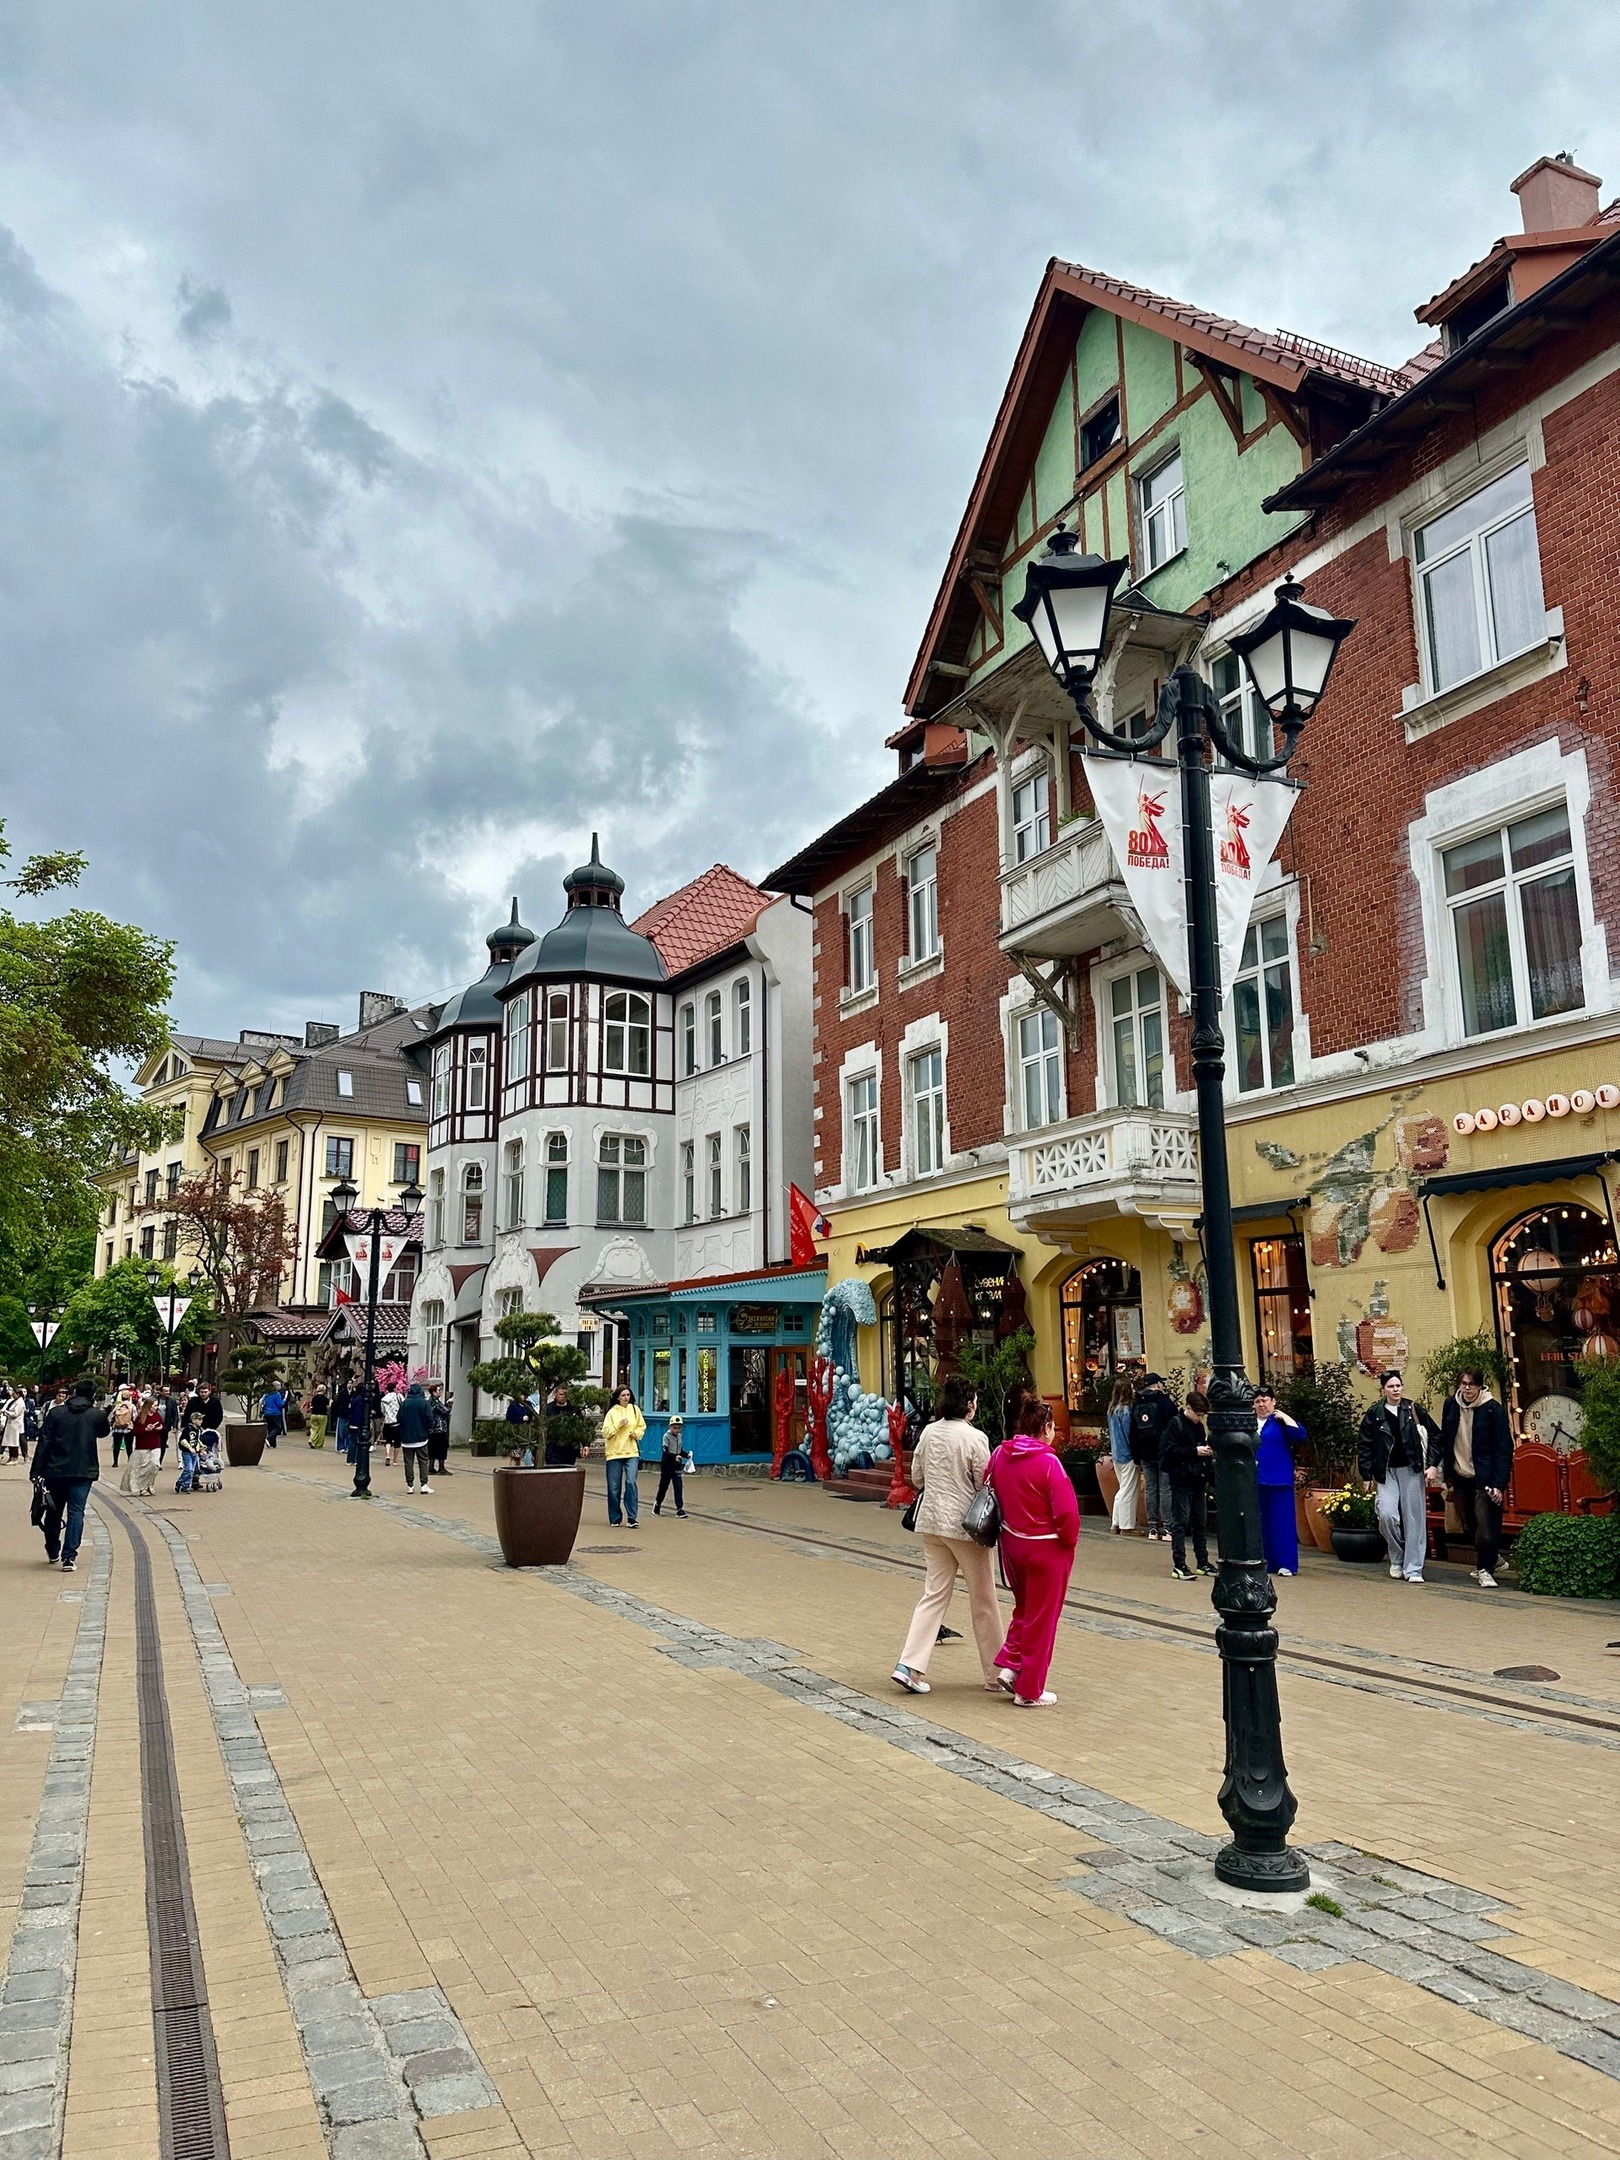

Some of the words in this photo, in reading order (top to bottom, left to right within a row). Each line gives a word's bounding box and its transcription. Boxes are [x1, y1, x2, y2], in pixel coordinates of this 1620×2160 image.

[1128, 830, 1149, 852] 80
[1127, 855, 1170, 870] ПОБЕДА!
[1532, 1411, 1541, 1420] 10
[1575, 1412, 1582, 1421] 2
[1530, 1422, 1537, 1431] 9
[1534, 1434, 1540, 1443] 8
